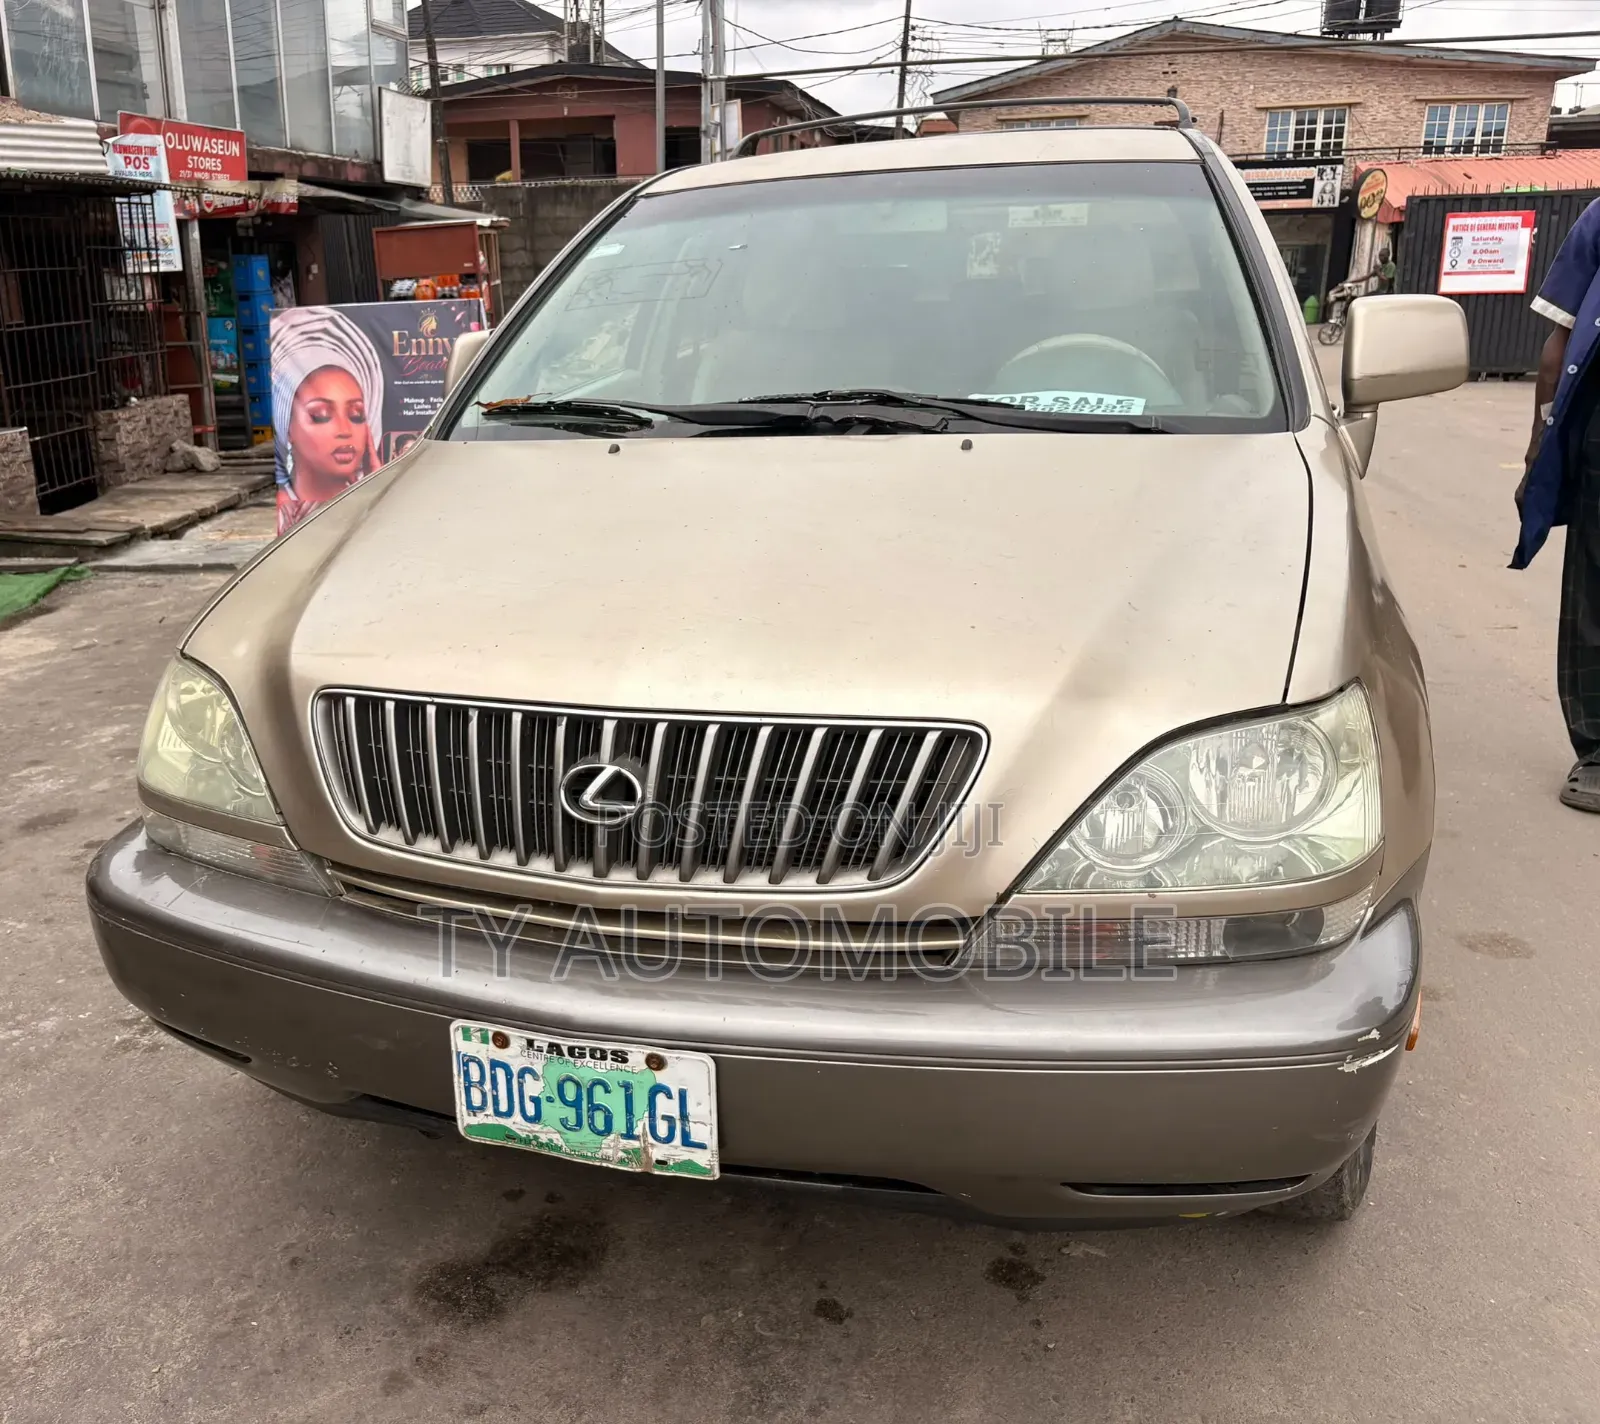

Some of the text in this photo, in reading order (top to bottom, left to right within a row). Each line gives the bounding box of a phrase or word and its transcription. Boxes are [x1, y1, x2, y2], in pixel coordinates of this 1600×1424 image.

[165, 132, 240, 157] OLUWASEUN
[123, 156, 150, 170] POS
[187, 155, 222, 171] STORES
[212, 172, 230, 180] STREET
[1284, 169, 1314, 178] HAIRS
[1452, 223, 1469, 233] NOTICE
[1477, 222, 1497, 232] GENERAL
[1498, 221, 1519, 232] MEETING
[392, 331, 456, 356] Enny
[400, 356, 449, 377] Beaut
[986, 395, 1039, 404] OR
[526, 1038, 629, 1064] LAGOS
[520, 1050, 637, 1075] CENTRE OF EXCELLENCE
